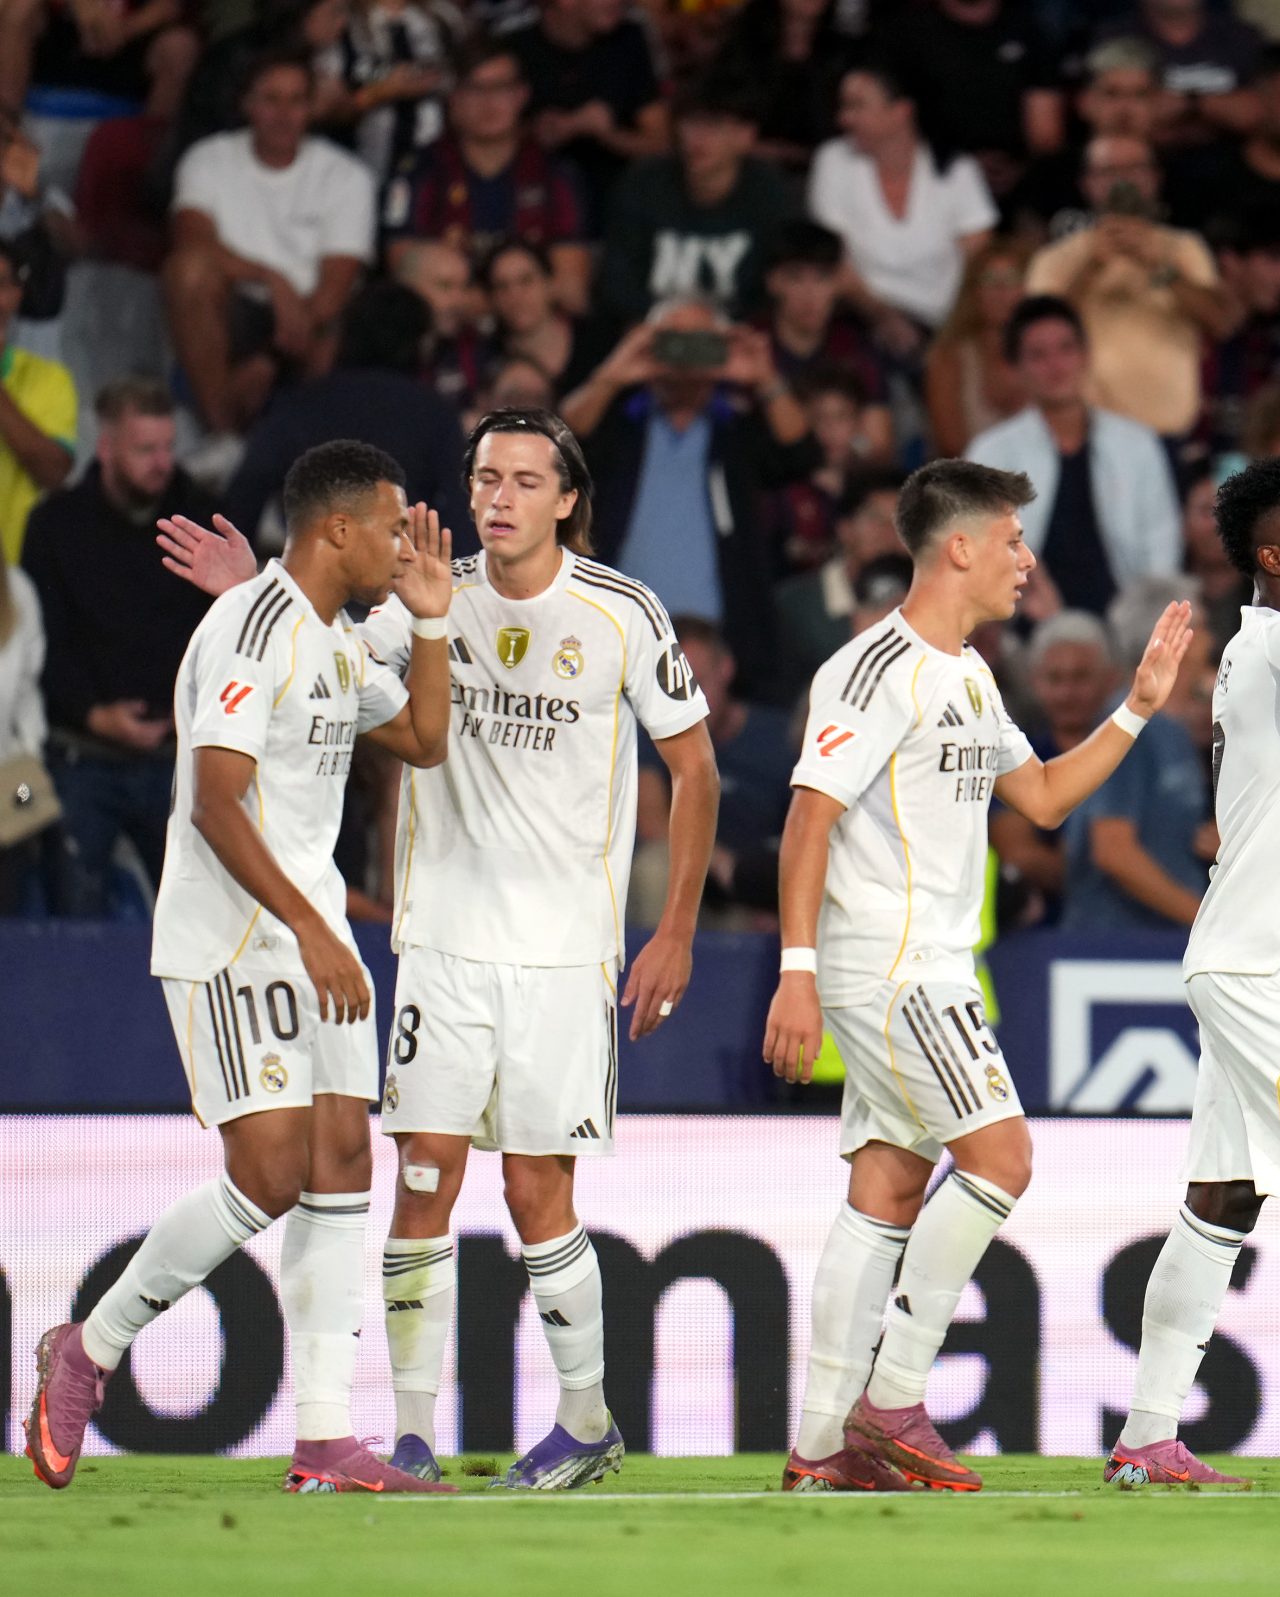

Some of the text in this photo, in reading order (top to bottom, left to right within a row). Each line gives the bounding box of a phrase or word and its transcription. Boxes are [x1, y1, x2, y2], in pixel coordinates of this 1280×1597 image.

[488, 721, 557, 752] BETTER
[236, 979, 300, 1045] 10
[941, 1000, 1000, 1061] 15
